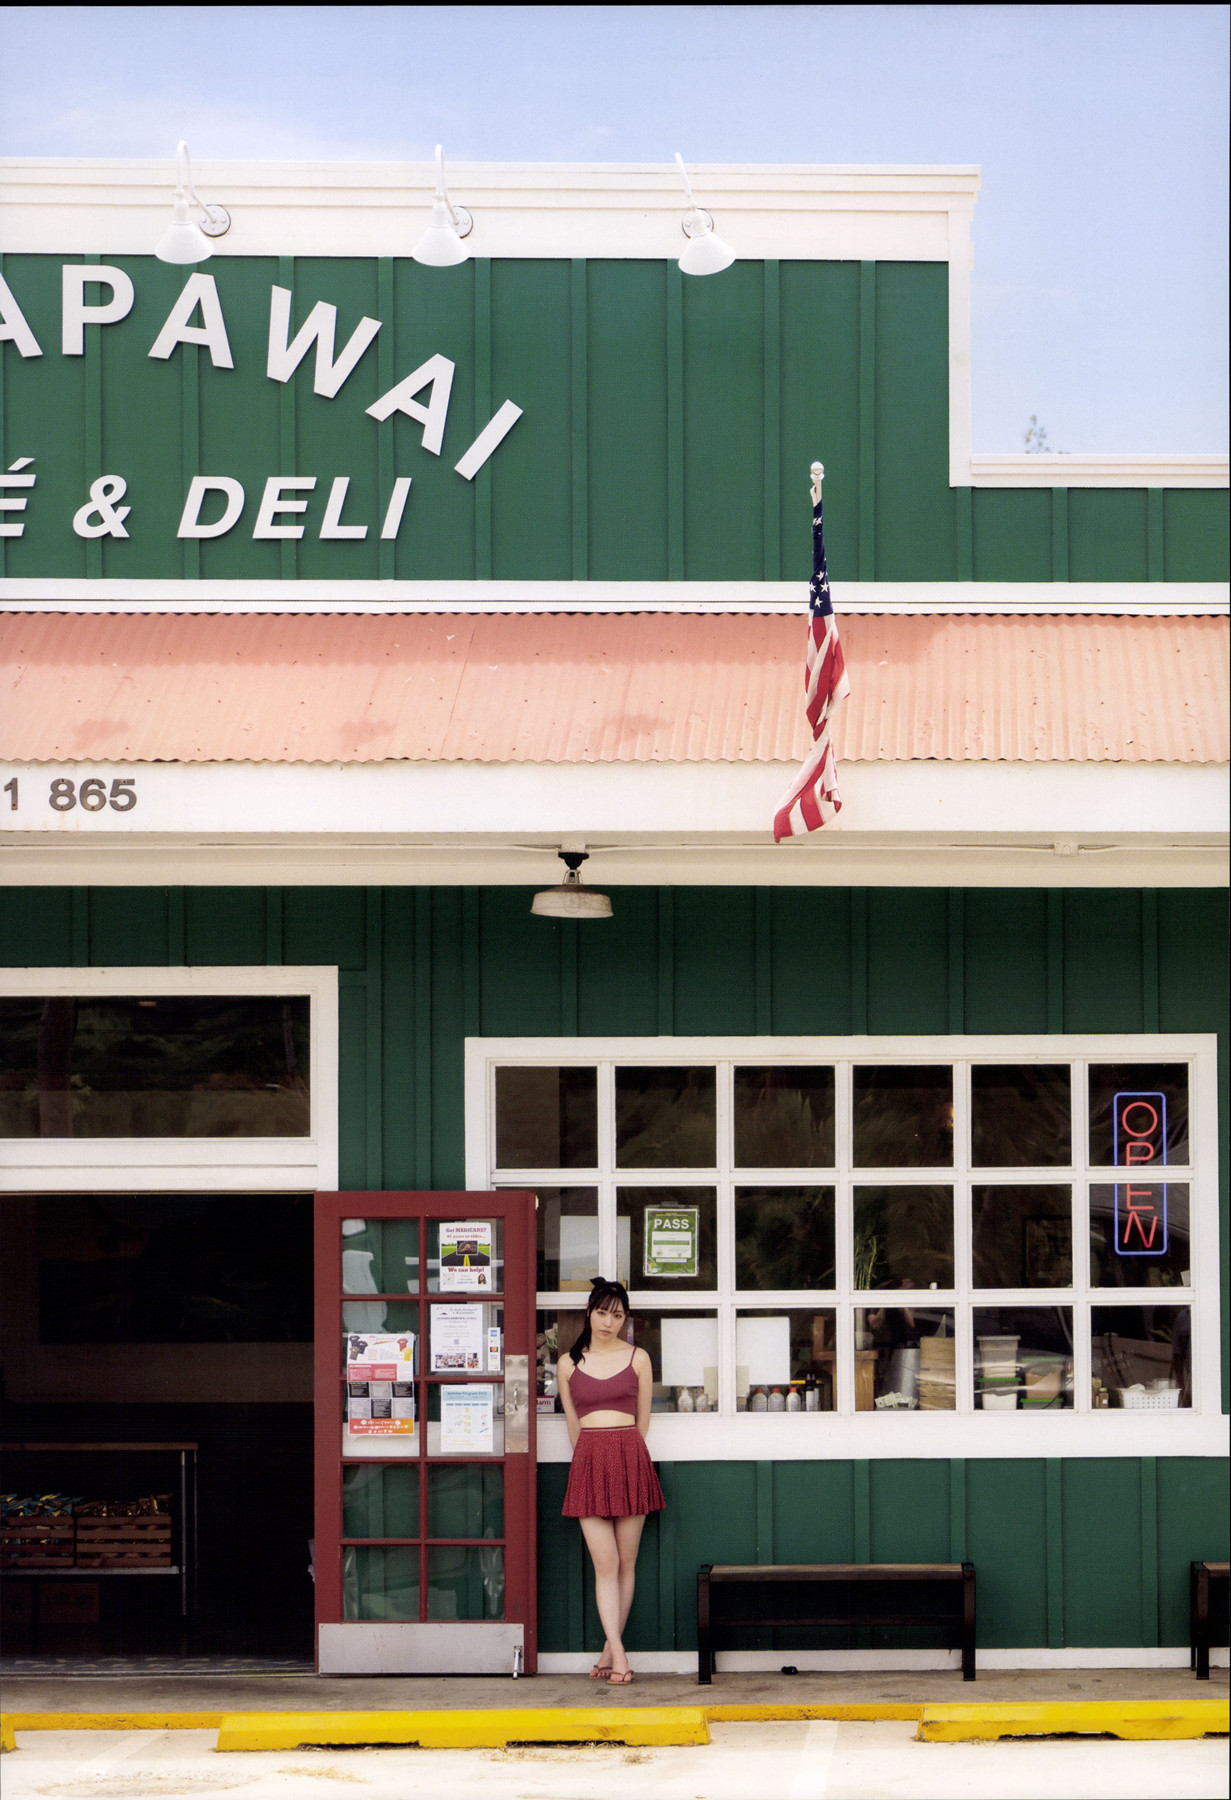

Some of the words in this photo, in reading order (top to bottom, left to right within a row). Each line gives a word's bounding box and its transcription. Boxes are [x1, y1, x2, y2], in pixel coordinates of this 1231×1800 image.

[72, 475, 132, 539] &
[177, 476, 412, 540] DELI
[49, 778, 137, 812] 865
[1122, 1102, 1158, 1248] OPEN
[654, 1218, 690, 1229] PASS
